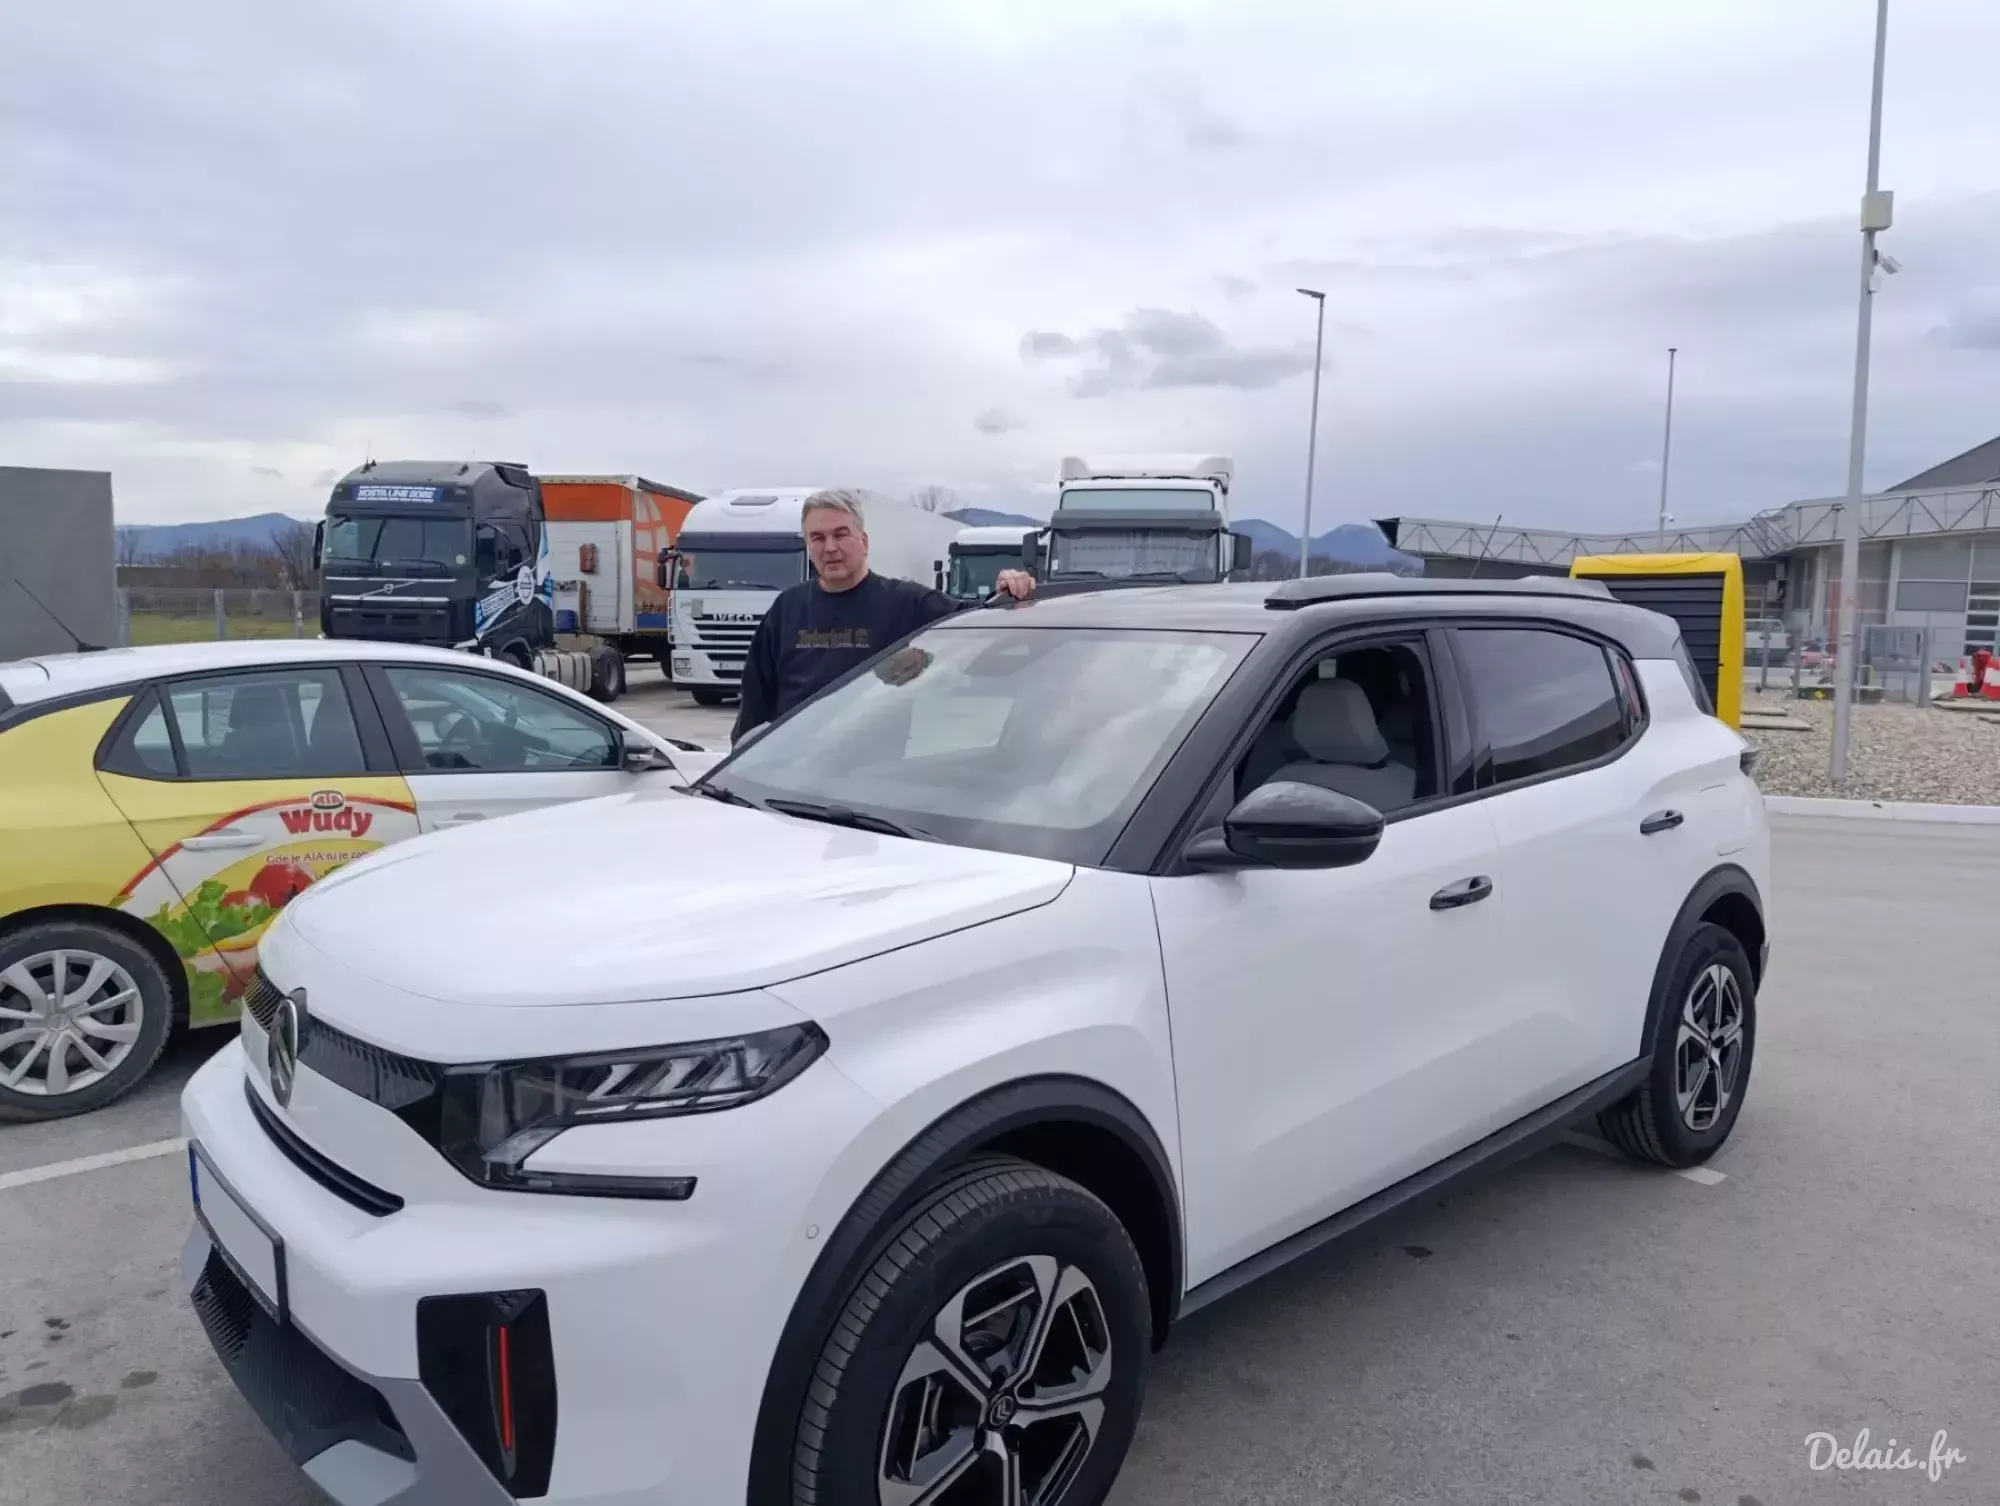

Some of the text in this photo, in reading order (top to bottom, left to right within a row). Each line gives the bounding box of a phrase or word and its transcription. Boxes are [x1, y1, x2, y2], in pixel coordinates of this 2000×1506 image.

[712, 613, 754, 621] IVECO
[279, 806, 373, 838] Wudy
[266, 854, 289, 864] Gde
[291, 854, 301, 864] je
[327, 851, 337, 861] tu
[339, 850, 349, 862] je
